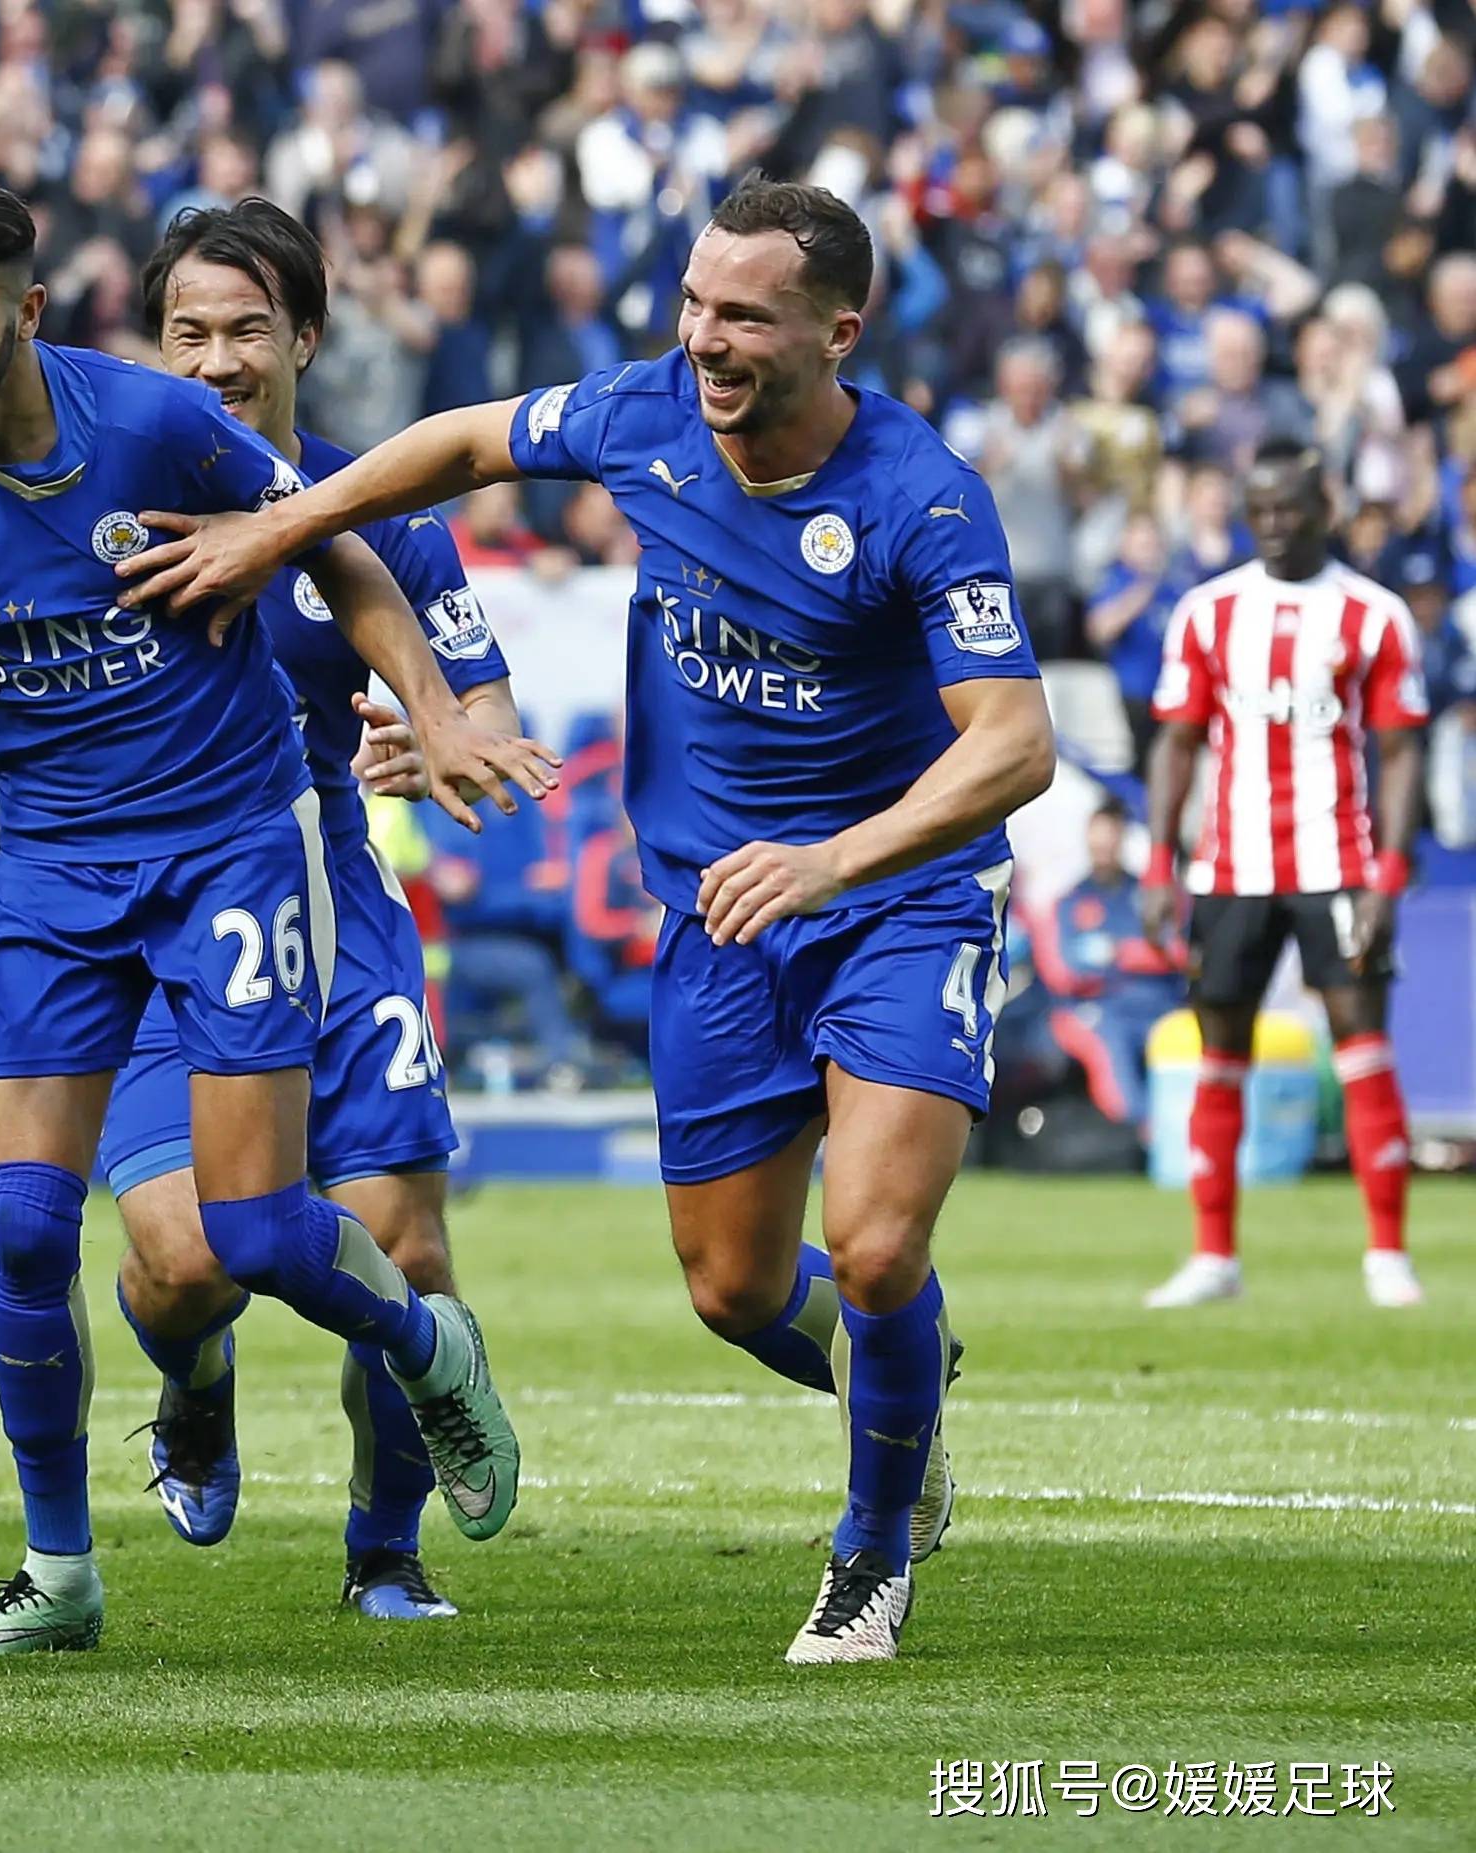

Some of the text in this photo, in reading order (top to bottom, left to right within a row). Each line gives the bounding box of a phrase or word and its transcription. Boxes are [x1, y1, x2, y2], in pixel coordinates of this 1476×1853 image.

[655, 585, 821, 673] KING
[663, 633, 823, 712] POWER
[964, 624, 1009, 639] BARCLAYS
[212, 896, 305, 1008] 26
[942, 942, 982, 1040] 4
